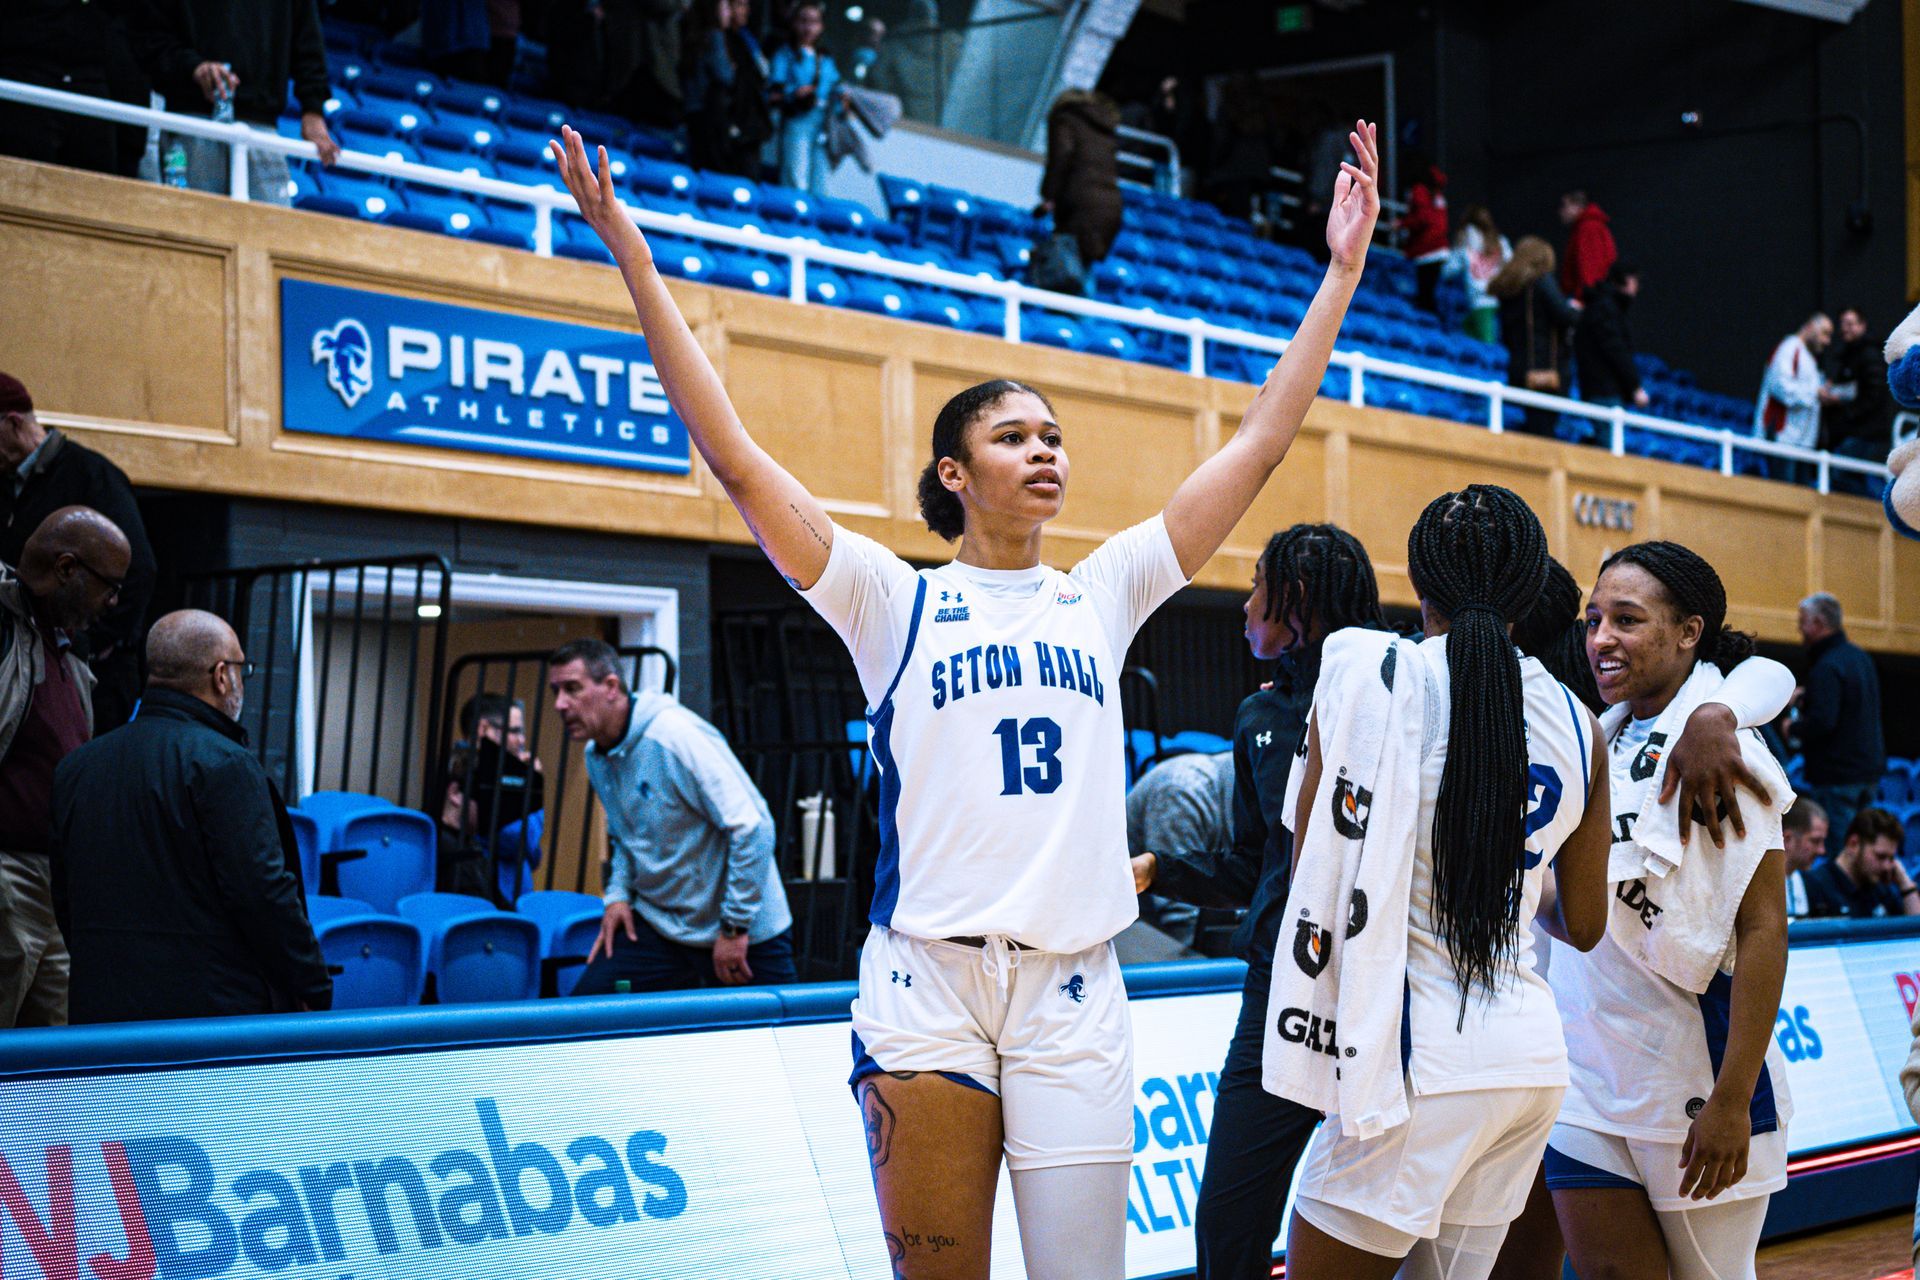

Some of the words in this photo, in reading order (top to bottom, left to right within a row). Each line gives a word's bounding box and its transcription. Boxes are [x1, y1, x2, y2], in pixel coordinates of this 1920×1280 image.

[388, 325, 670, 415] PIRATE
[387, 391, 670, 444] ATHLETICS
[934, 613, 970, 623] CHANGE
[952, 606, 968, 614] THE
[932, 644, 1022, 710] SETON
[1033, 641, 1104, 708] HALL
[992, 717, 1062, 795] 13
[901, 1226, 921, 1247] be
